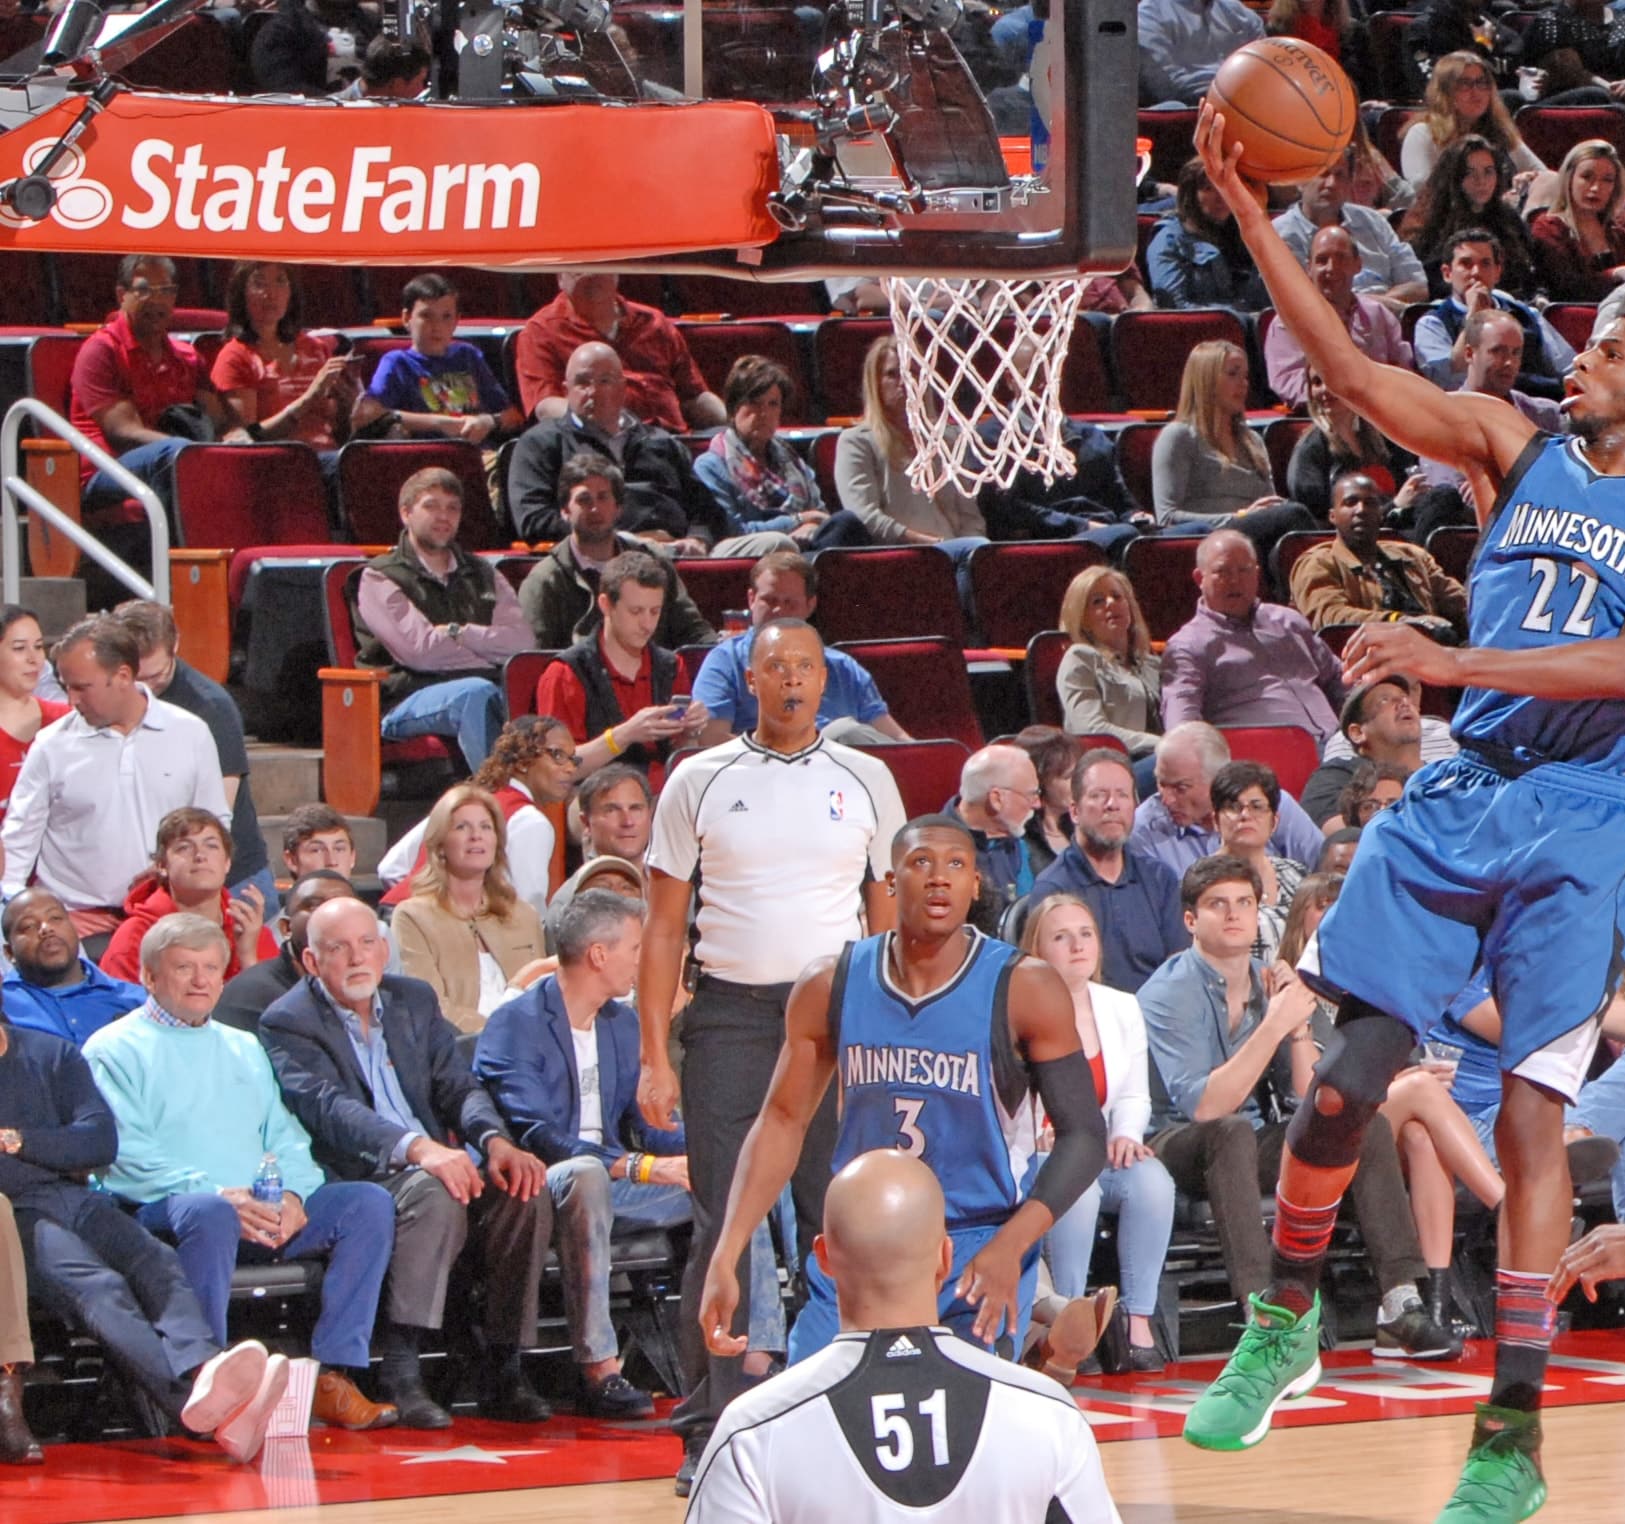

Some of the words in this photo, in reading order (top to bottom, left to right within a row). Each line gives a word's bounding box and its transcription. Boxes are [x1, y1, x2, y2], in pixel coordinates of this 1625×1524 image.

[1511, 557, 1599, 637] 22
[847, 1044, 981, 1097] MINNESOTA
[894, 1097, 926, 1159] 3
[871, 1388, 950, 1471] 51
